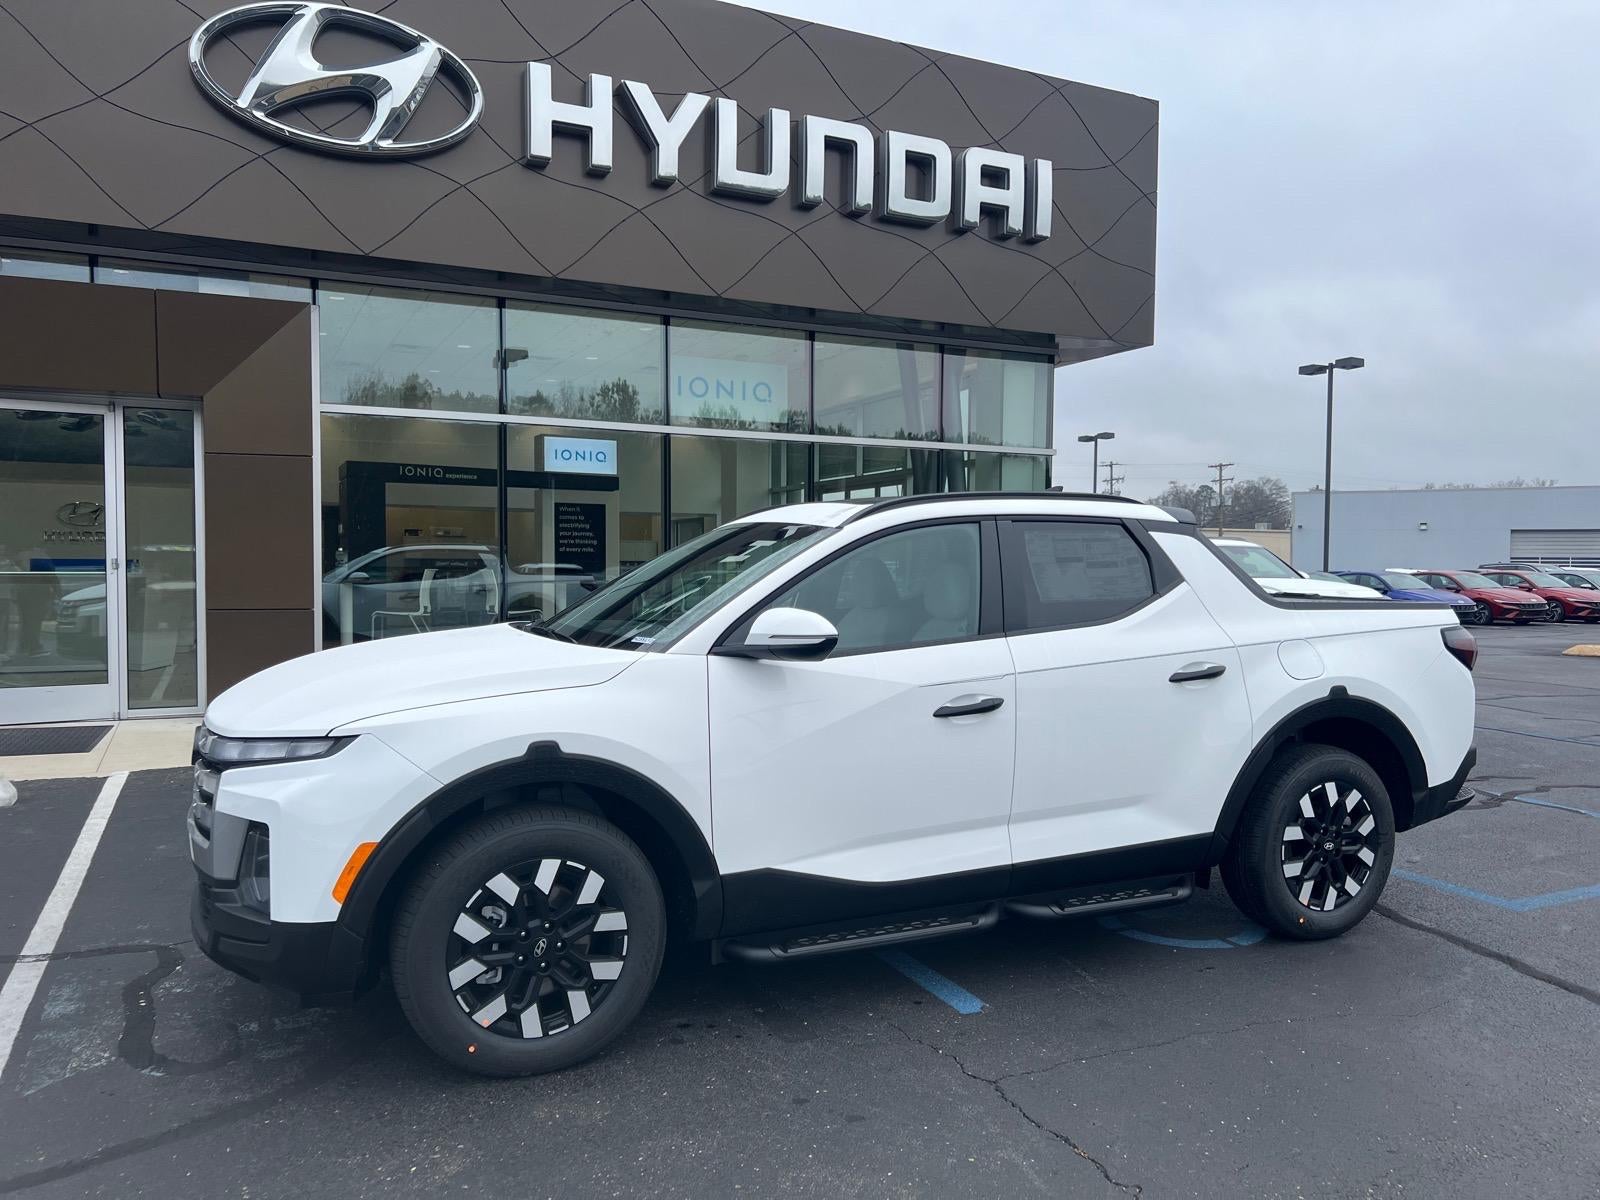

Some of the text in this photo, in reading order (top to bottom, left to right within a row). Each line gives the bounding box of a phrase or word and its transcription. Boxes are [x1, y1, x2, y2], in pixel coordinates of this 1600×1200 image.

[524, 60, 1053, 242] HYUNDAI
[677, 375, 772, 403] IONIQ
[554, 448, 607, 463] IONIQ
[400, 465, 478, 480] IONIQ experience
